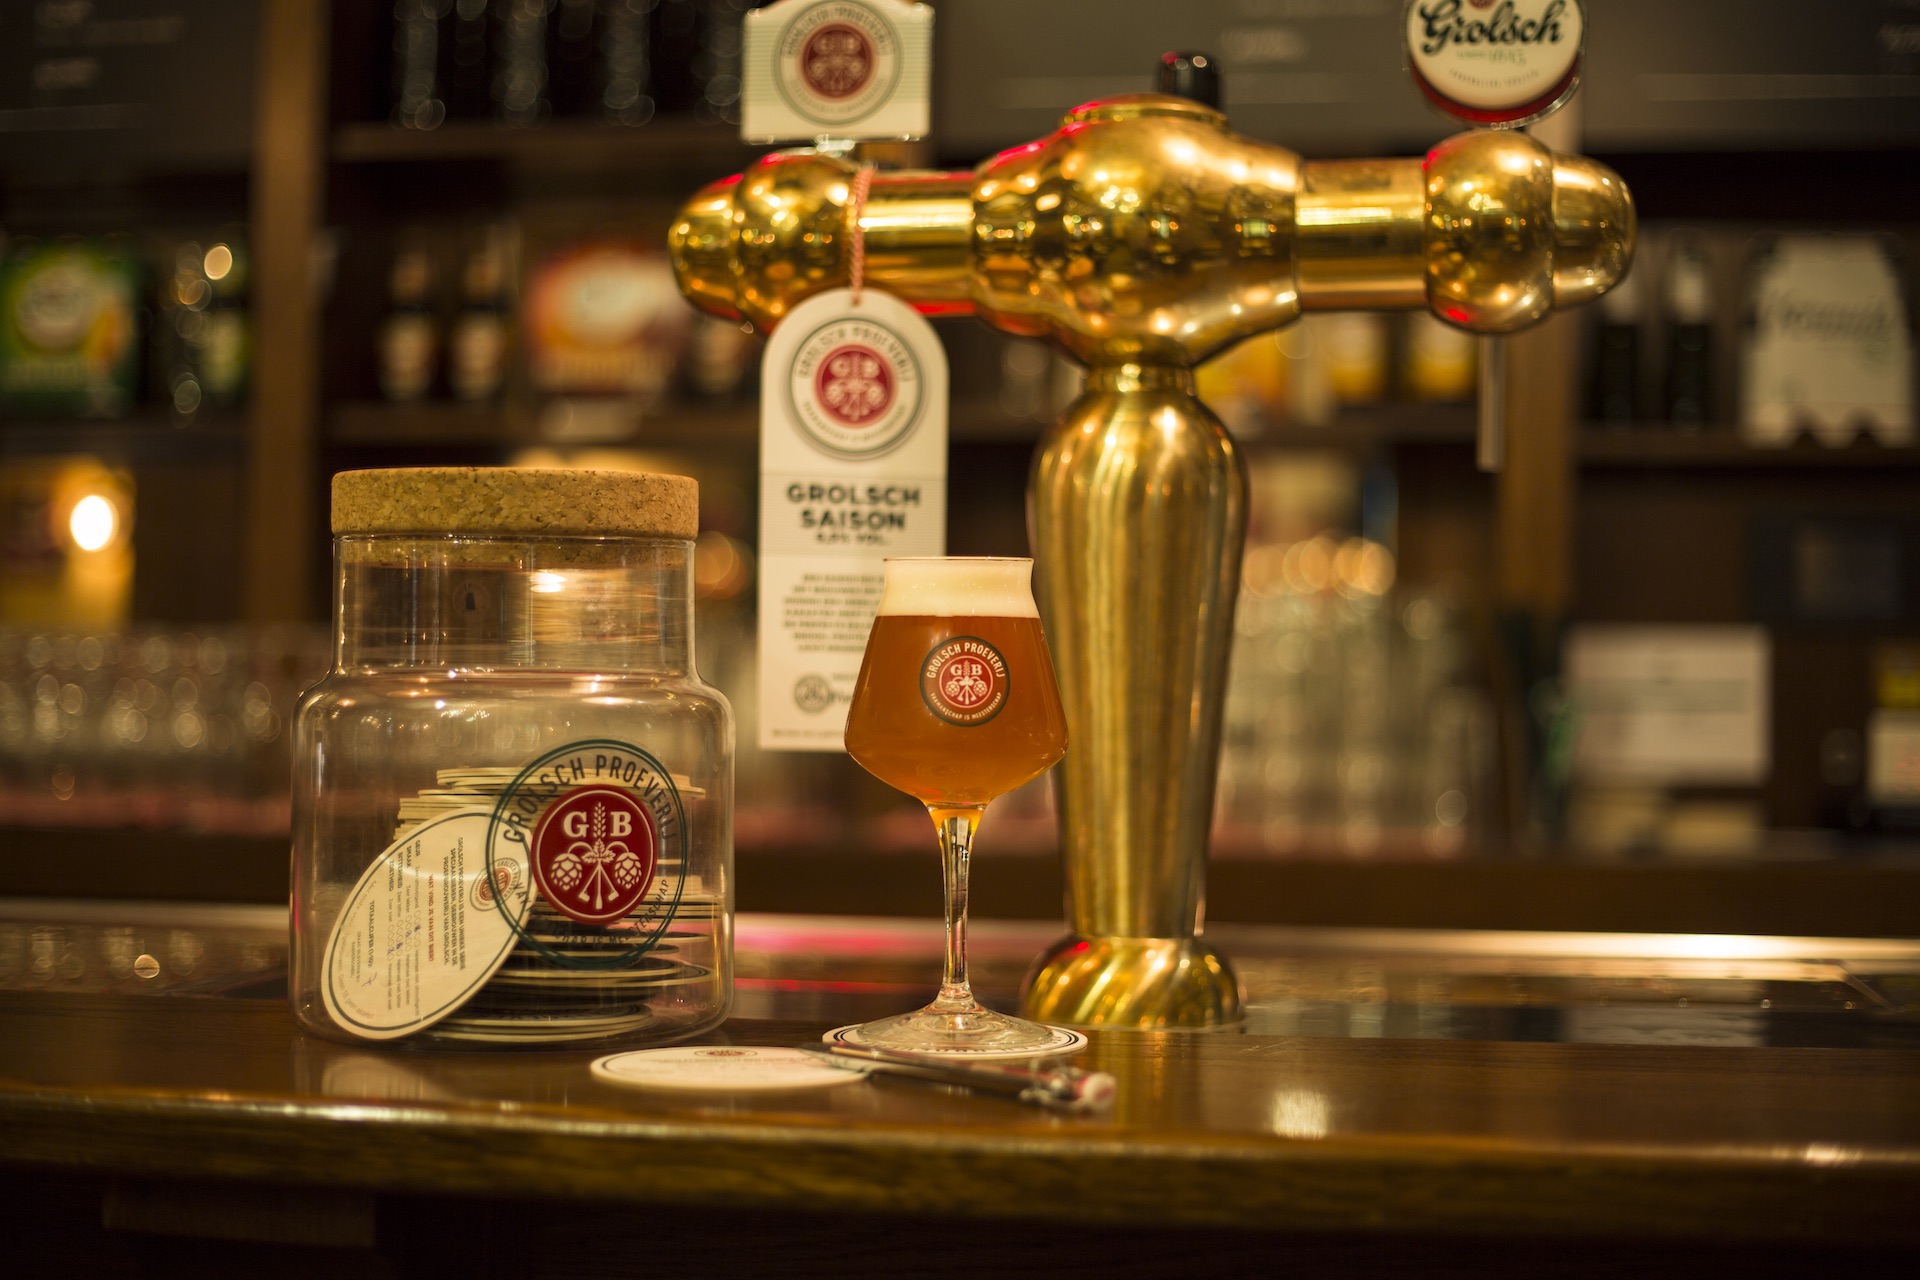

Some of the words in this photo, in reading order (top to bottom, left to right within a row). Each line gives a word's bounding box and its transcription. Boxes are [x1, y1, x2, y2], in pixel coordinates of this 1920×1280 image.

[1419, 0, 1566, 56] Grolsch
[787, 483, 920, 506] GROLSCH
[801, 508, 906, 530] SAISON
[927, 643, 962, 679] GROLSCH
[964, 642, 1006, 678] PROEVERIJ
[503, 757, 585, 843] GROLSCH
[595, 754, 677, 842] PROEVERIJ
